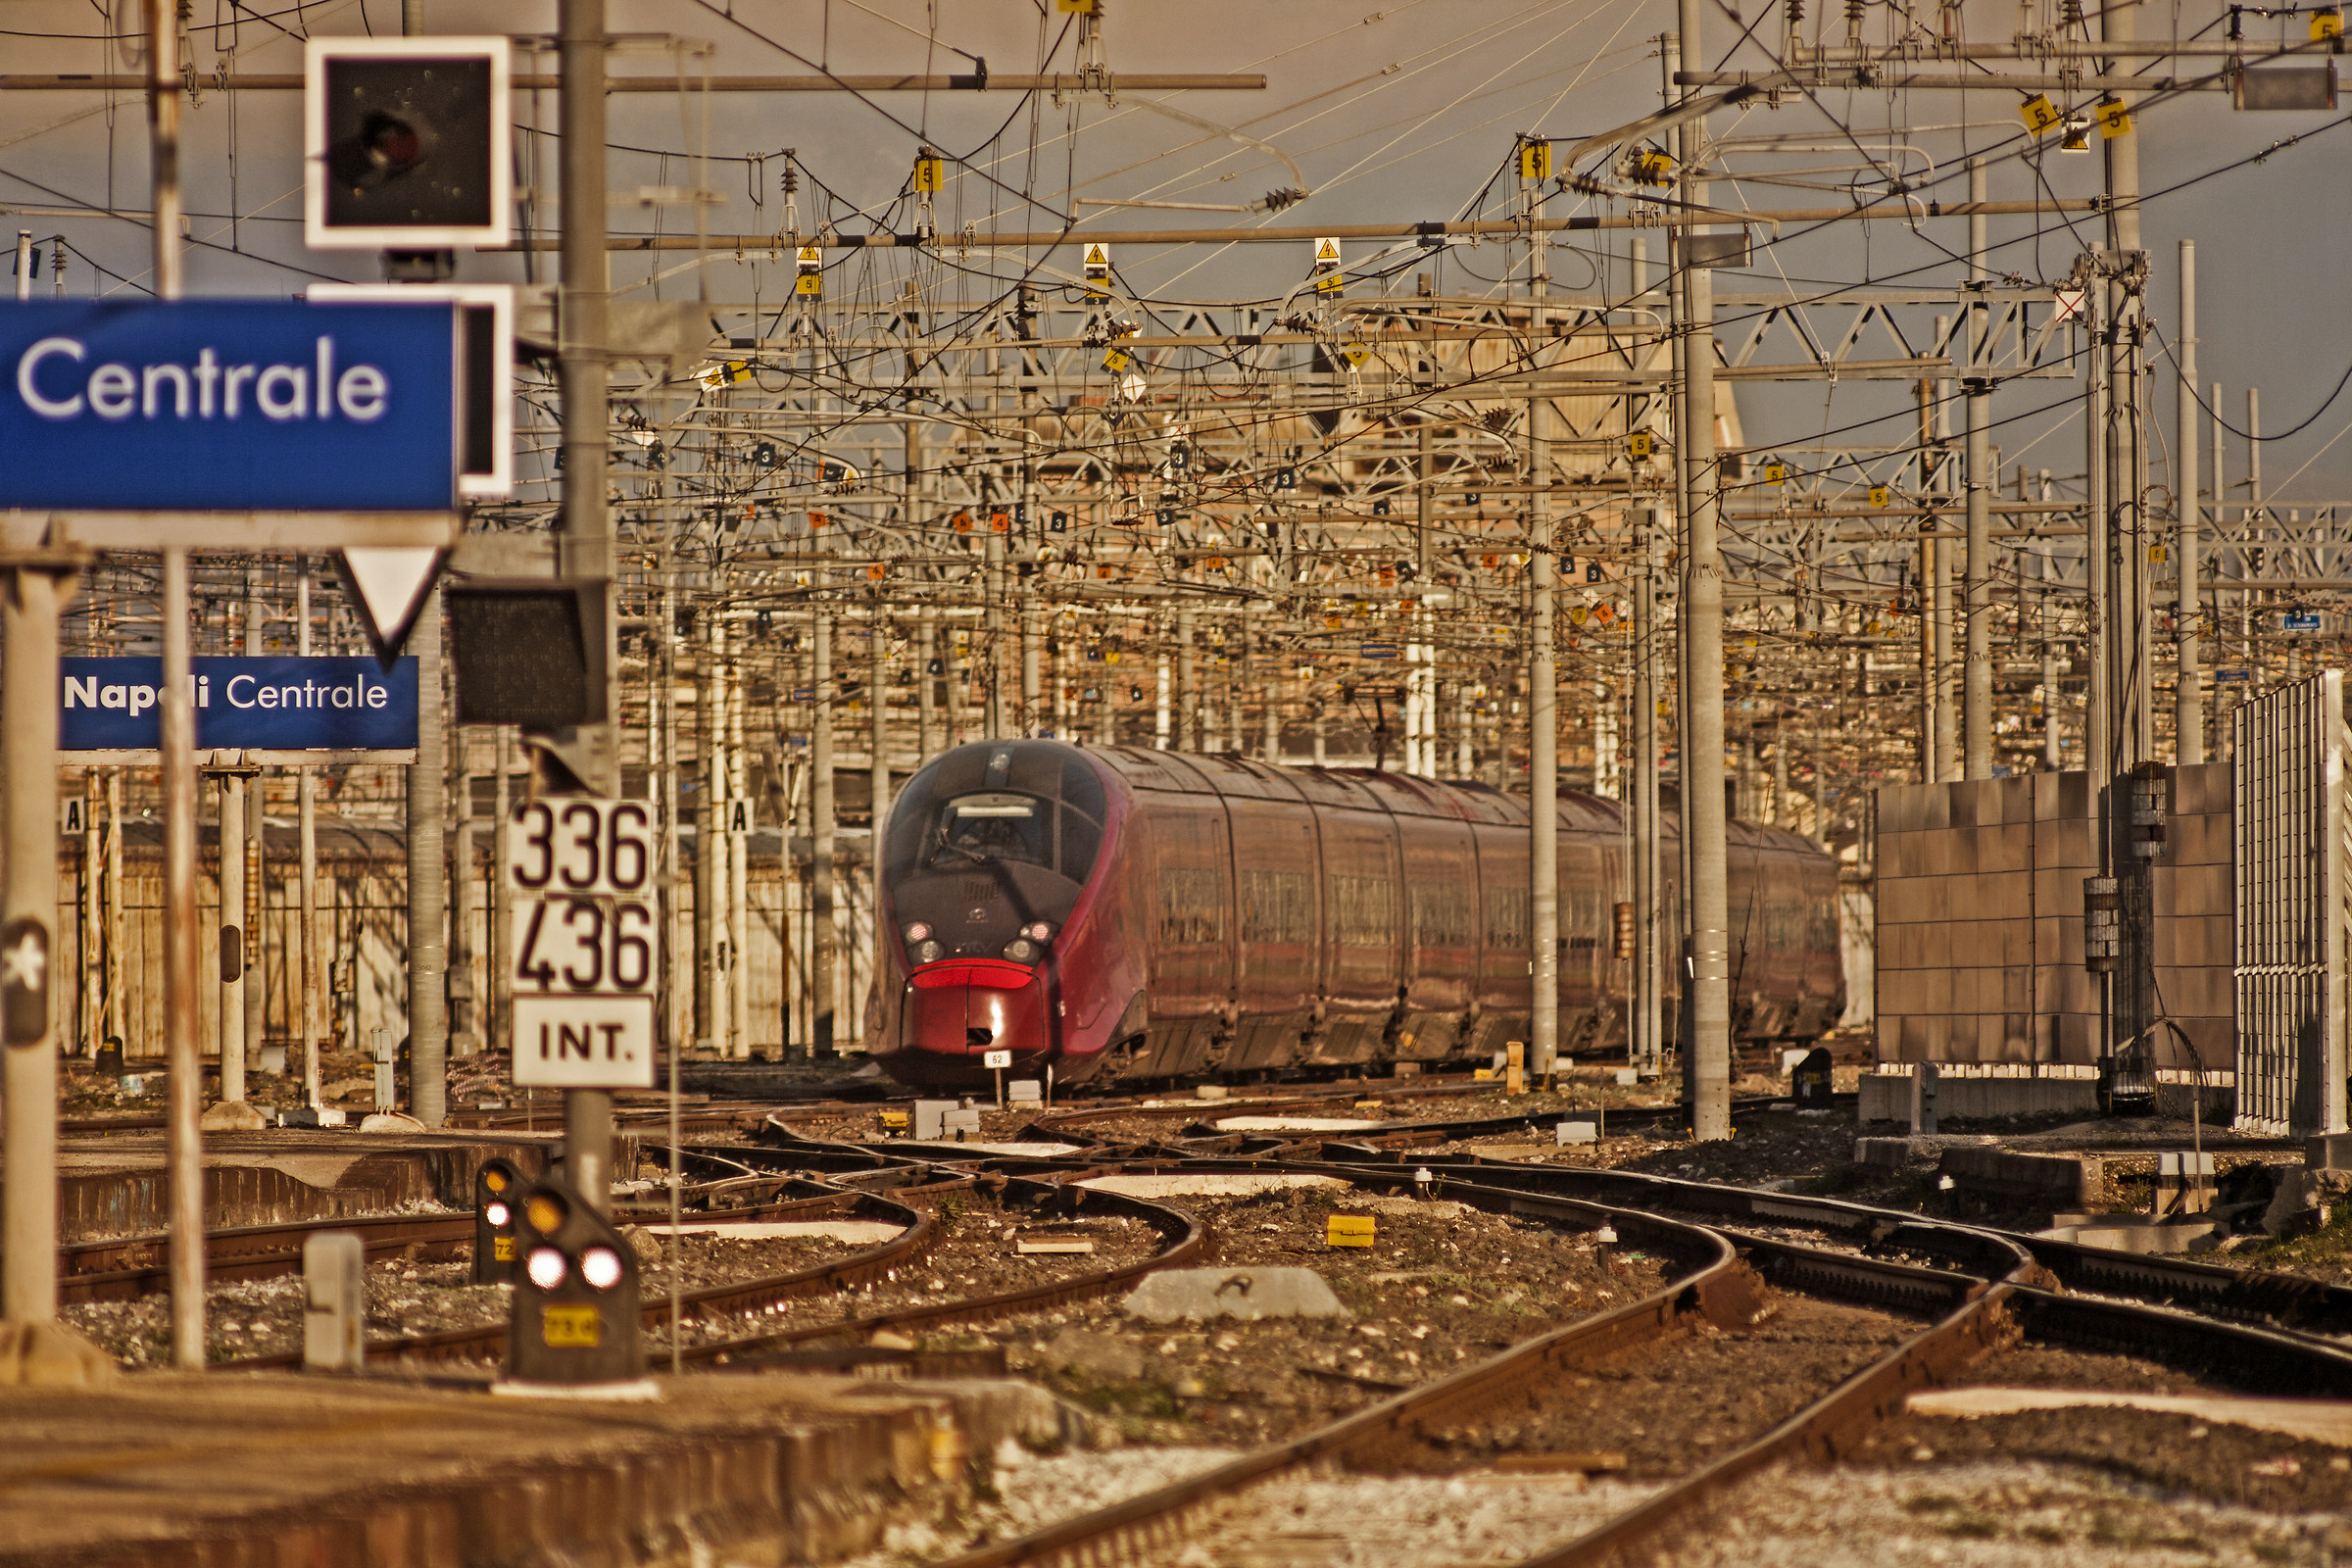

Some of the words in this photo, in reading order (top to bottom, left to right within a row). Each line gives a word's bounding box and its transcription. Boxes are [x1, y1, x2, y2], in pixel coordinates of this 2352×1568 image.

[2034, 108, 2047, 126] 5
[2108, 111, 2120, 127] 5
[806, 279, 812, 289] 5
[17, 335, 388, 419] Centrale
[1637, 439, 1643, 450] 5
[761, 451, 769, 463] 3
[1282, 473, 1290, 485] 3
[1772, 470, 1778, 480] 5
[1876, 492, 1882, 503] 5
[997, 518, 1003, 527] 4
[1055, 518, 1061, 529] 3
[1161, 514, 1167, 522] 3
[1565, 562, 1571, 571] 3
[1591, 569, 1596, 579] 3
[2295, 610, 2301, 619] 3
[64, 675, 210, 716] Napli
[226, 674, 388, 709] Centrale
[68, 801, 80, 831] A
[733, 802, 746, 831] A
[512, 802, 648, 891] 336
[515, 900, 651, 992] 436
[540, 1021, 634, 1061] INT.
[992, 1054, 1003, 1064] 62
[497, 1244, 512, 1255] 72
